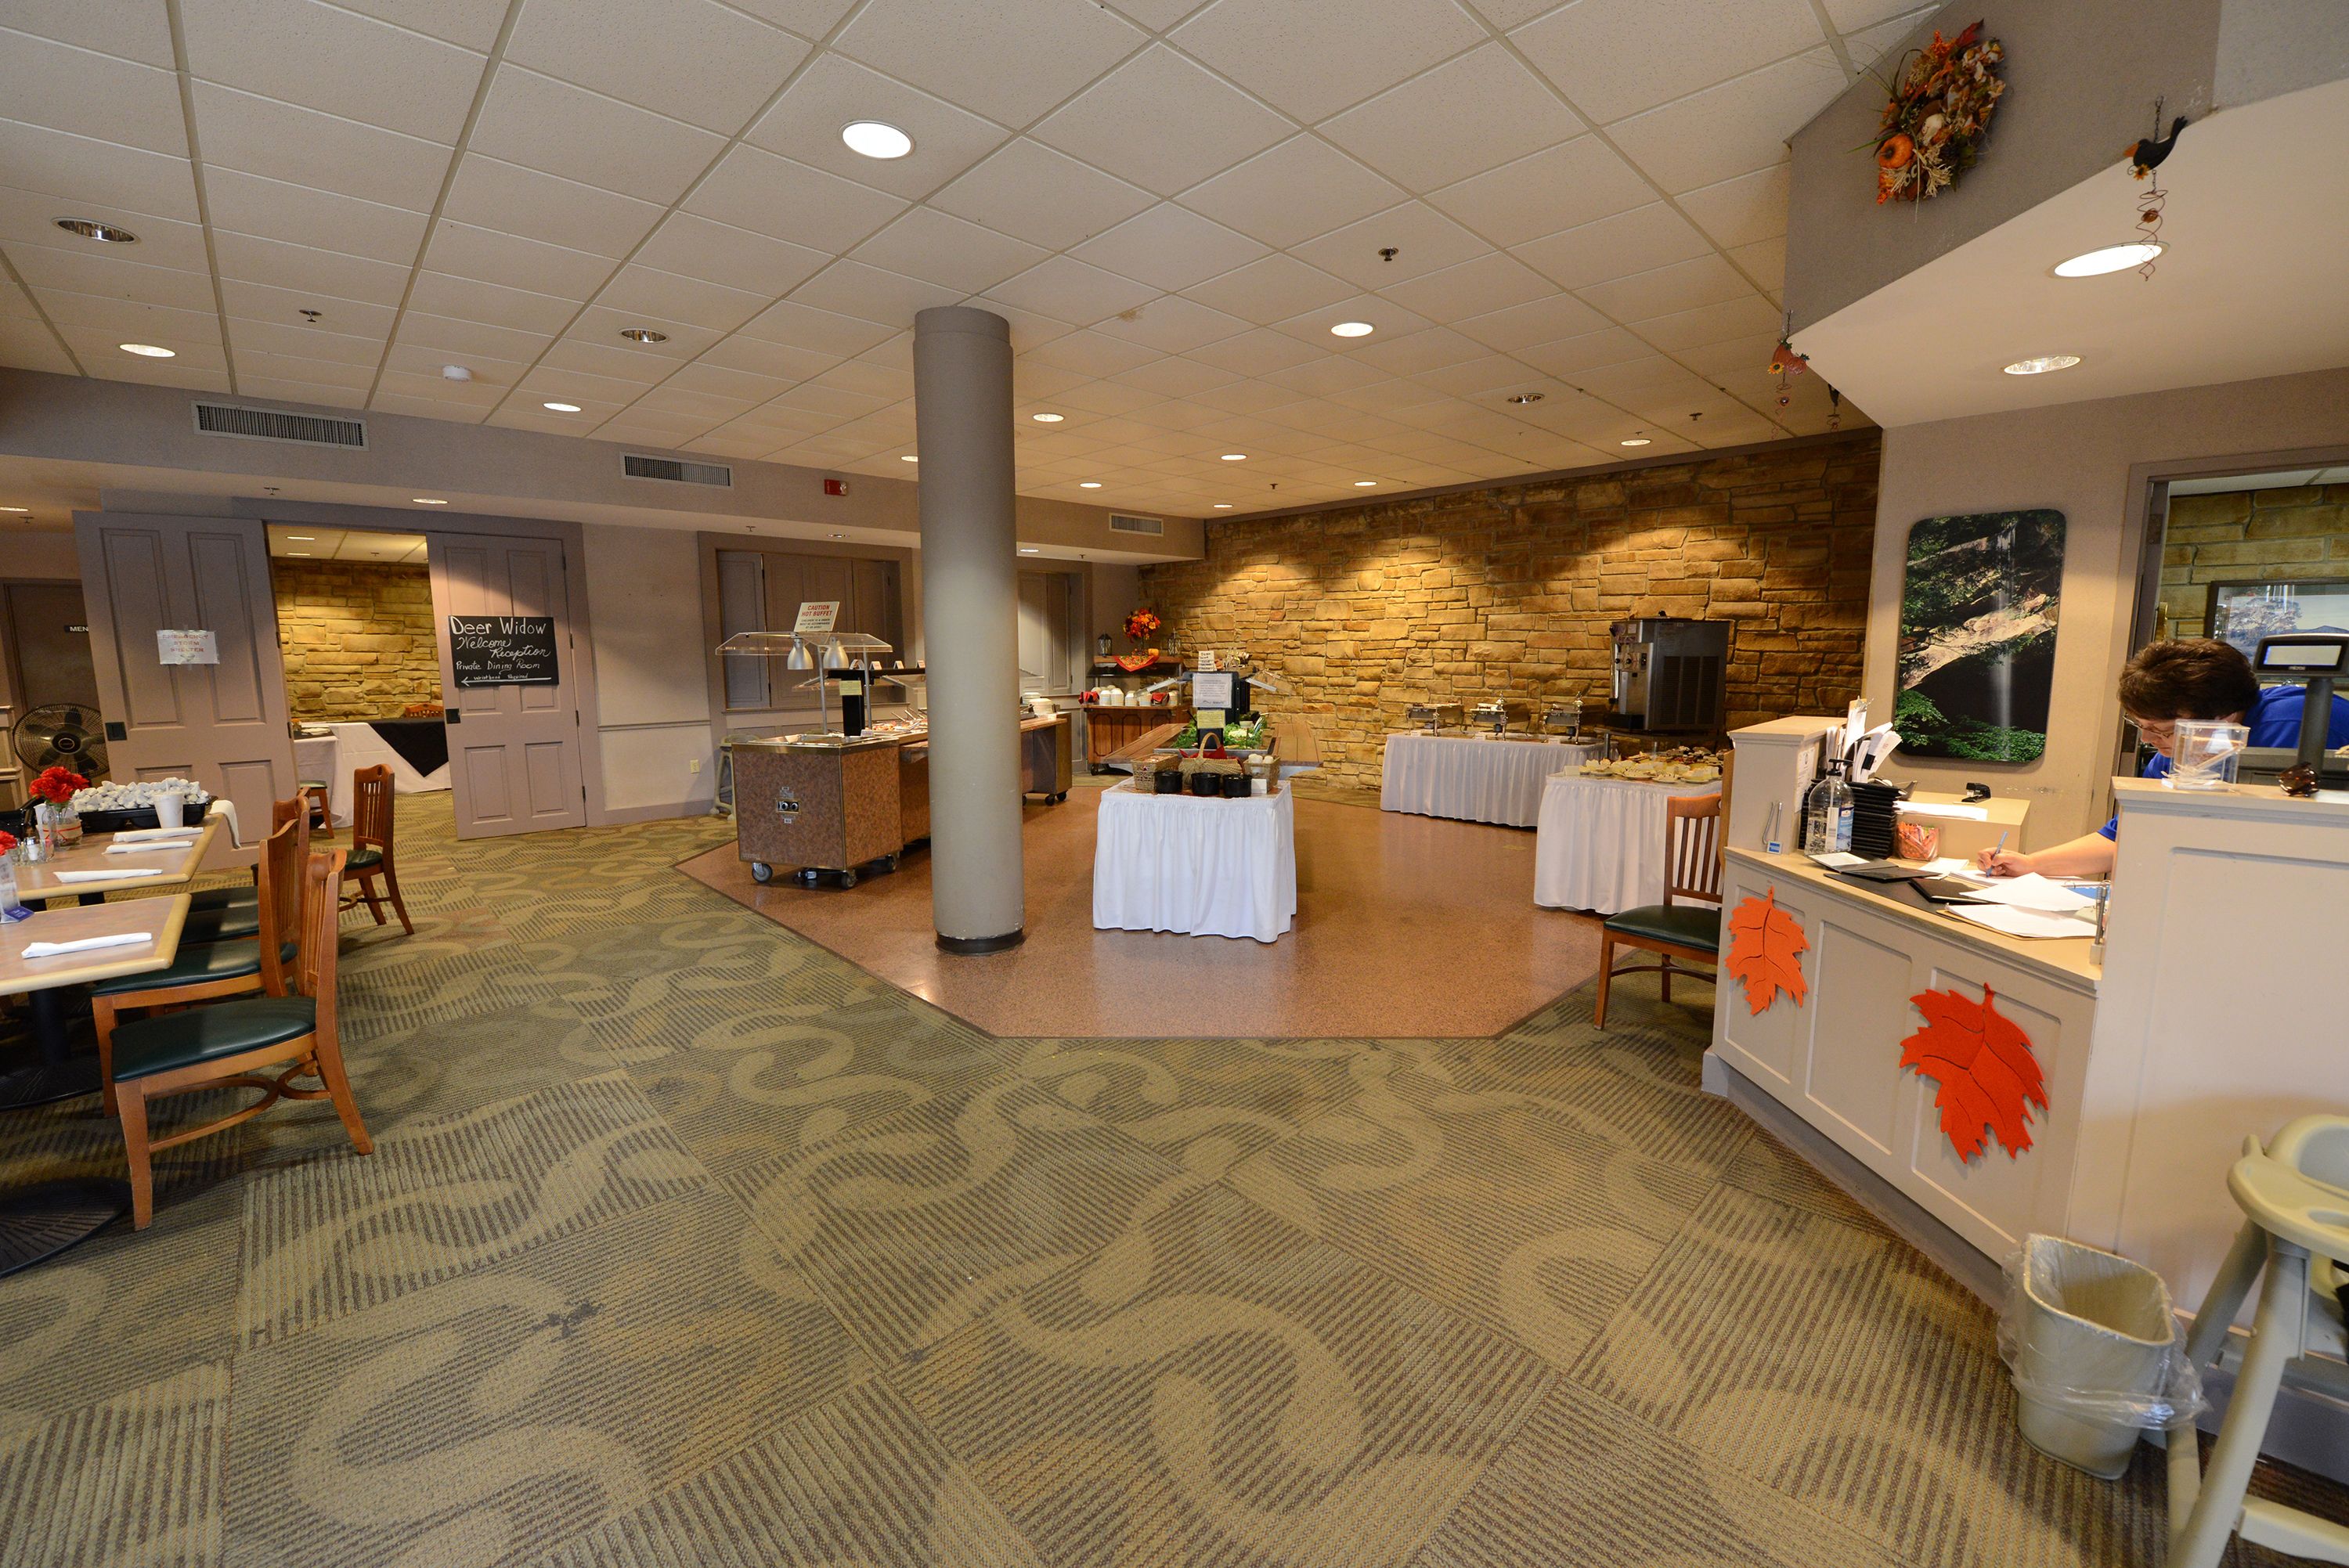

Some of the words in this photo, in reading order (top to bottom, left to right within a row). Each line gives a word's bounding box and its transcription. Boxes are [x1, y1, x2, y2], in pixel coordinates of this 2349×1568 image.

[450, 616, 492, 634] Deer
[499, 617, 547, 635] Widow
[456, 636, 512, 650] Welcome
[489, 644, 551, 661] Reception
[456, 660, 482, 671] Private
[486, 660, 513, 675] Dining
[517, 659, 540, 669] Room
